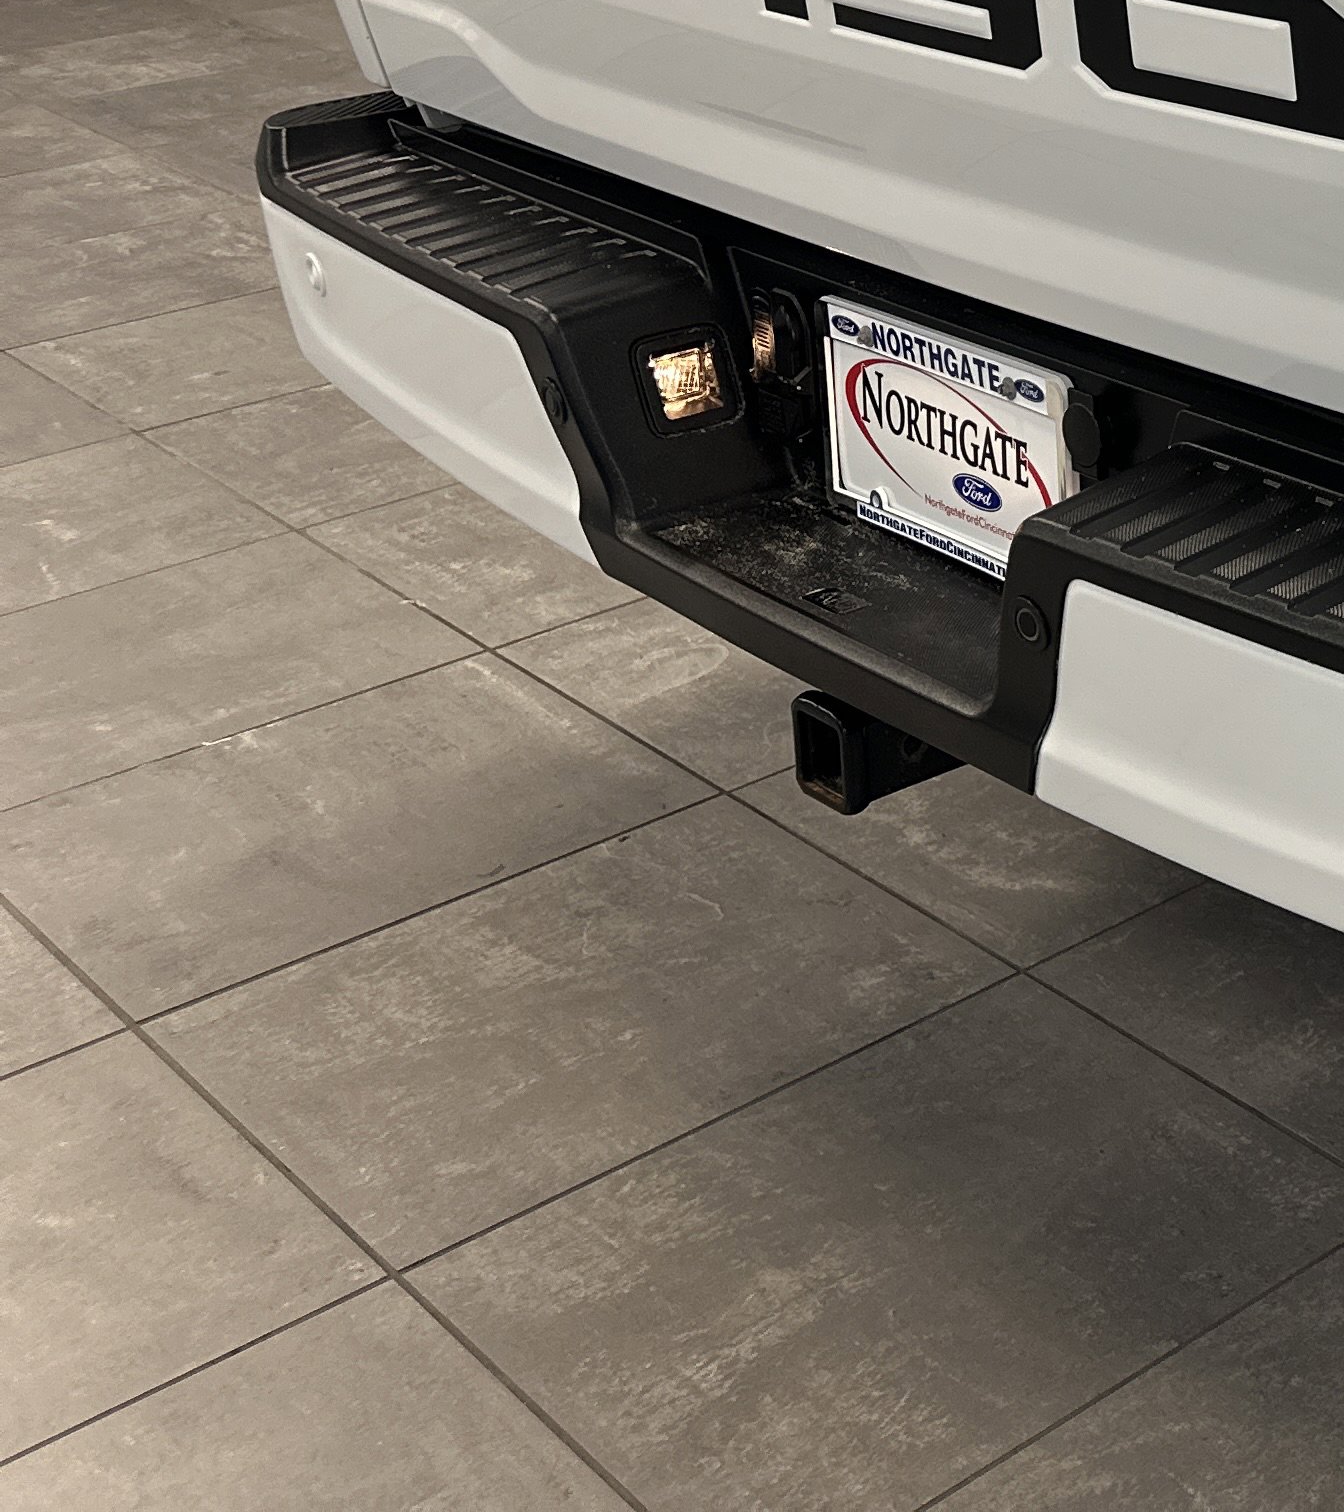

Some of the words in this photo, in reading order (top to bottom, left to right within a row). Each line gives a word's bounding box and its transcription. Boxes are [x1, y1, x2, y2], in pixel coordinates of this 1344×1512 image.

[871, 322, 1001, 393] NORTHGATE
[861, 367, 1030, 488] NORTHGATE
[961, 478, 993, 507] Ford
